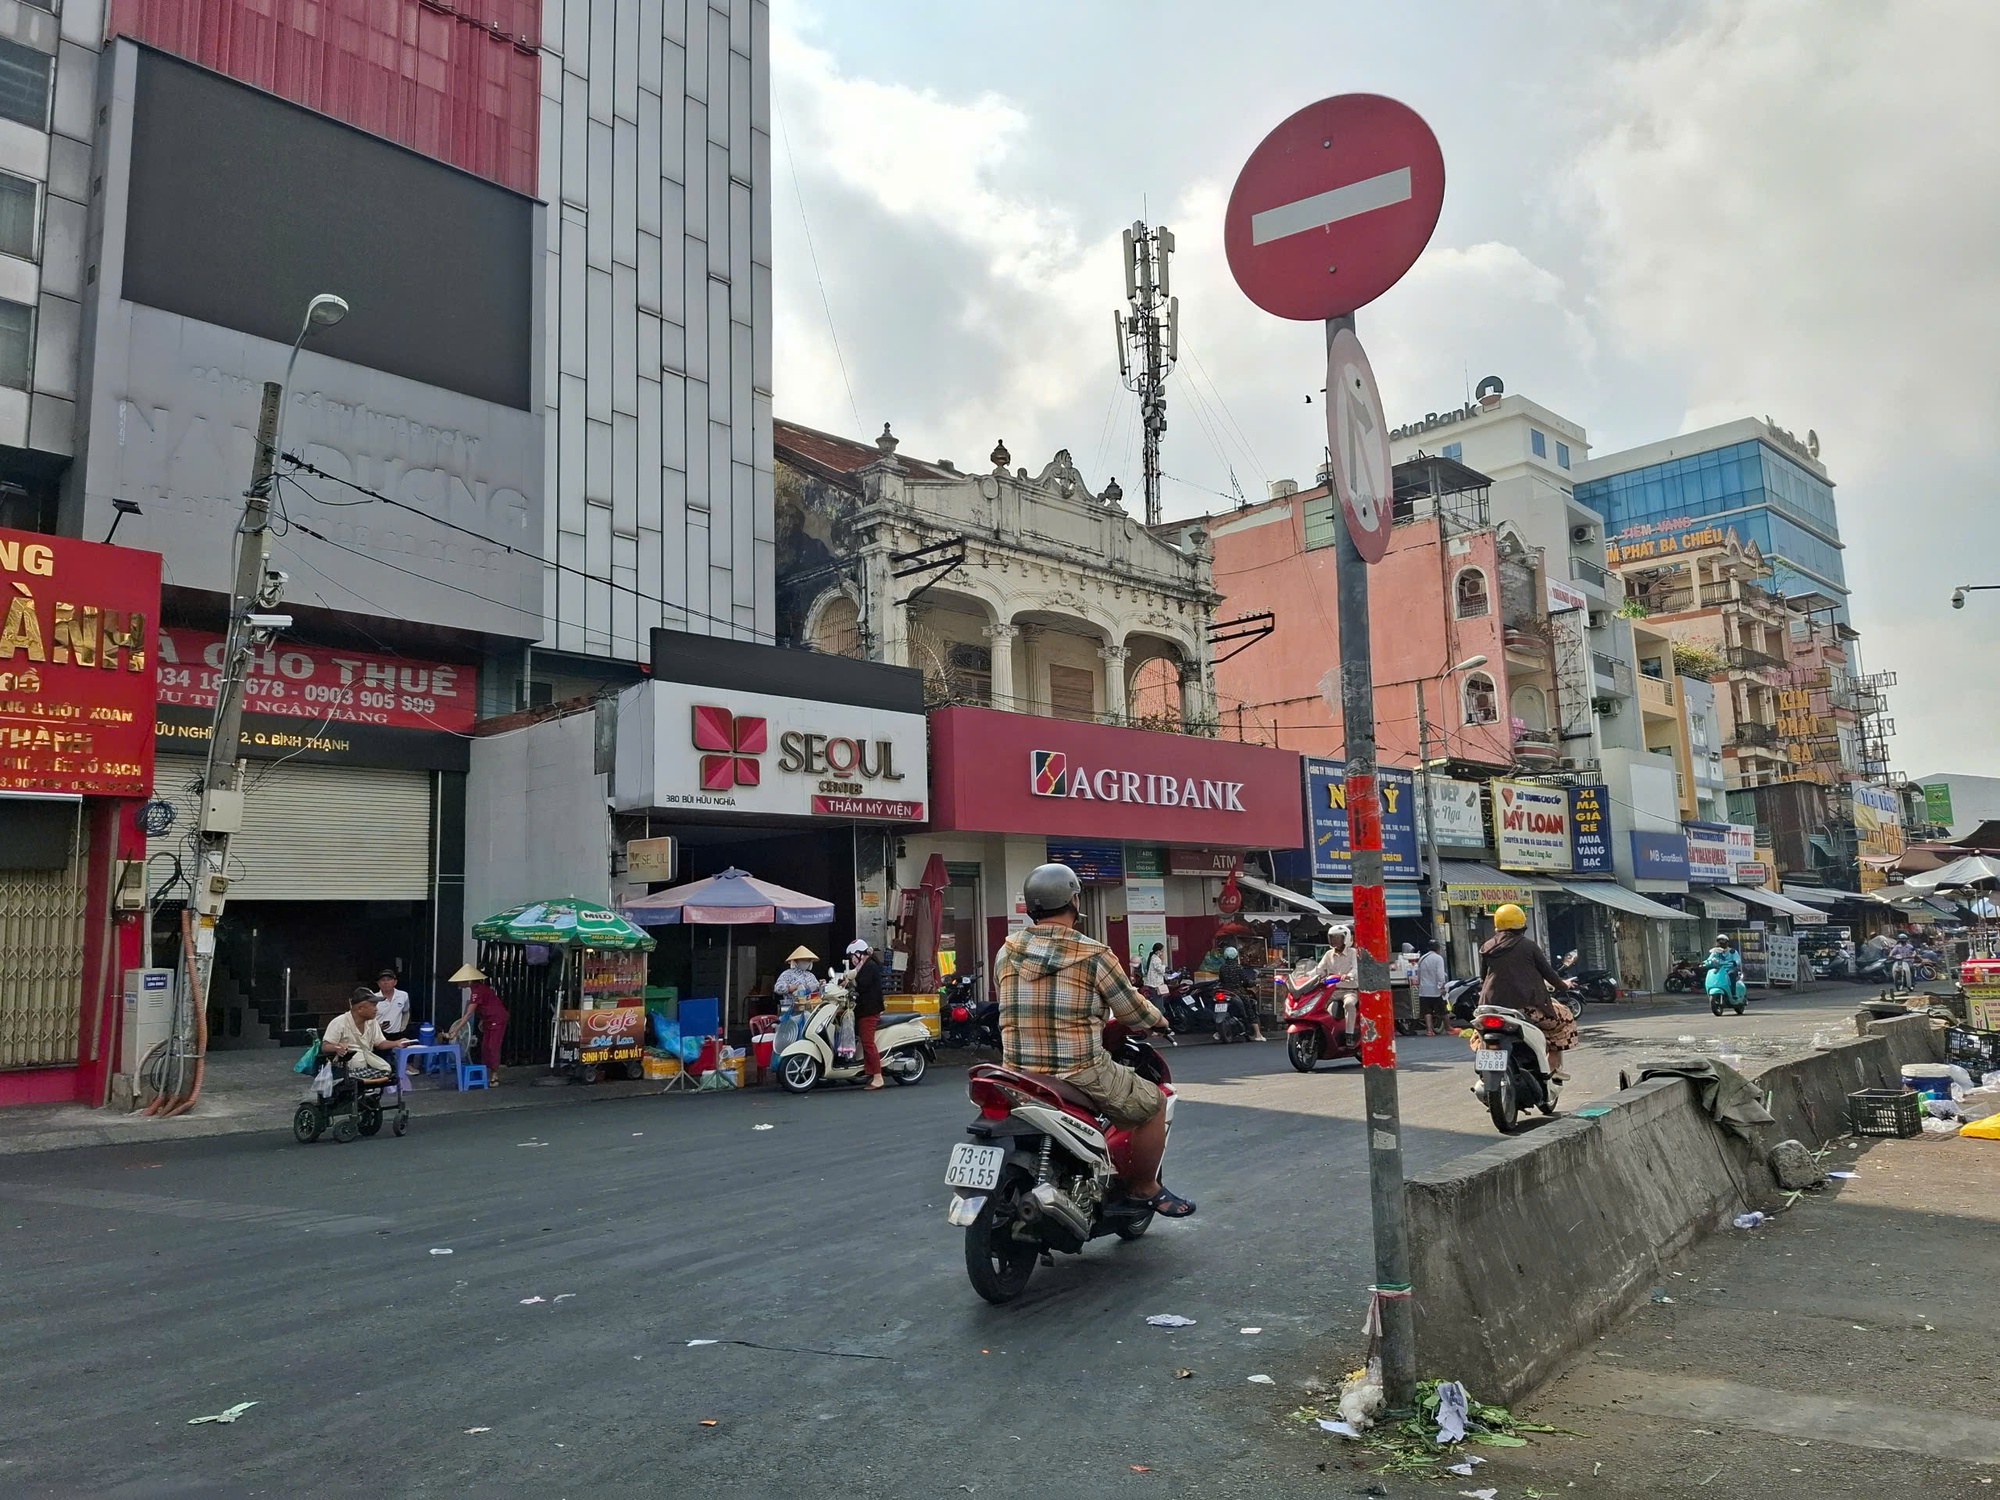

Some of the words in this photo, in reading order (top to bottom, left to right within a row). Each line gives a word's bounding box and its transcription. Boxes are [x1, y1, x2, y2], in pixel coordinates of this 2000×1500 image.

[1659, 533, 1678, 552] BÀ
[331, 655, 458, 698] THUÊ
[303, 684, 354, 706] 0903
[359, 690, 395, 709] 905
[257, 698, 321, 720] NGÂN
[326, 706, 388, 725] HÀNG
[271, 732, 302, 748] BÌNH
[305, 737, 350, 753] THẠNH
[778, 730, 906, 781] SEOUL
[102, 762, 142, 778] SẠCH
[818, 779, 864, 795] CENTER
[1067, 767, 1247, 812] AGRIBANK
[1581, 789, 1594, 798] XI
[666, 795, 680, 803] 380
[1576, 801, 1600, 811] MẠ
[866, 801, 883, 814] MỸ
[885, 803, 912, 818] VIỆN
[1575, 811, 1602, 821] GIÁ
[1503, 804, 1525, 831] MỸ
[1526, 811, 1564, 835] LOAN
[1579, 835, 1601, 845] MUA
[1577, 845, 1606, 855] VÀNG
[1649, 850, 1660, 861] MB
[1660, 854, 1684, 863] SmartBank
[1212, 854, 1238, 869] ATM
[1583, 858, 1601, 868] BẠC
[584, 912, 613, 921] MILO
[582, 1051, 598, 1063] SINH
[599, 1047, 608, 1061] TỐ
[614, 1049, 629, 1060] CAM
[1478, 1061, 1505, 1069] 576.88
[949, 1166, 995, 1186] 051.55
